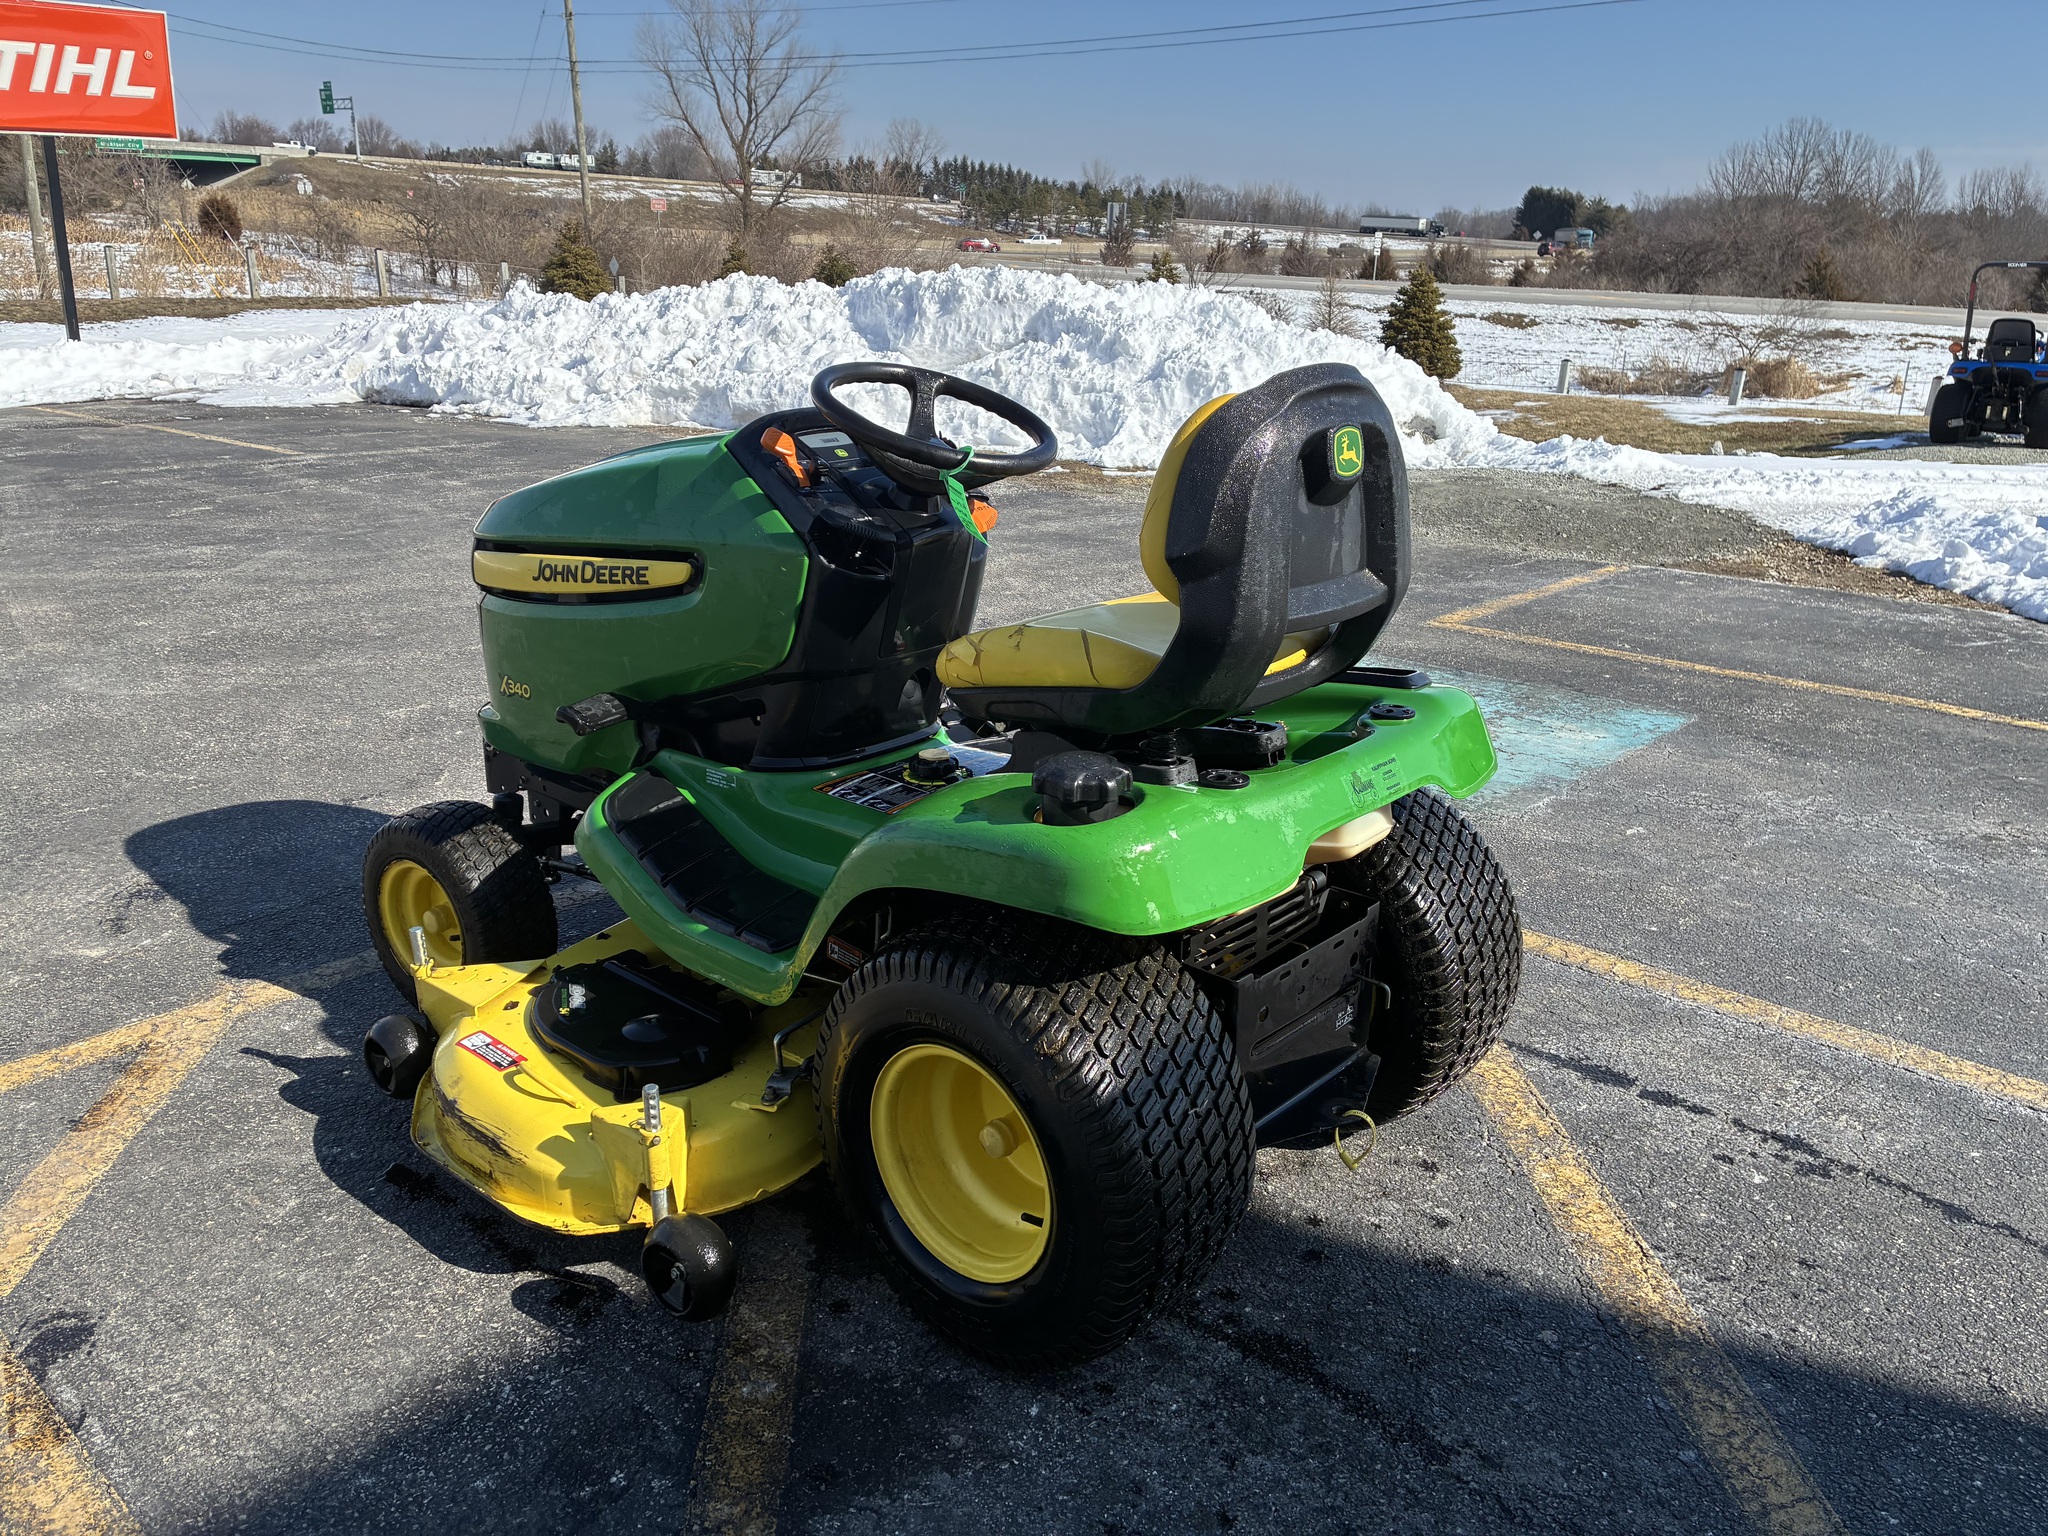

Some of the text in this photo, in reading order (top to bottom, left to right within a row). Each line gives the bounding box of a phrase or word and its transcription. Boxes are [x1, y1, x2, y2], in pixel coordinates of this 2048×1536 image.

[0, 40, 156, 99] TIHL
[532, 559, 650, 585] JOHN DEERE
[499, 674, 532, 700] X340
